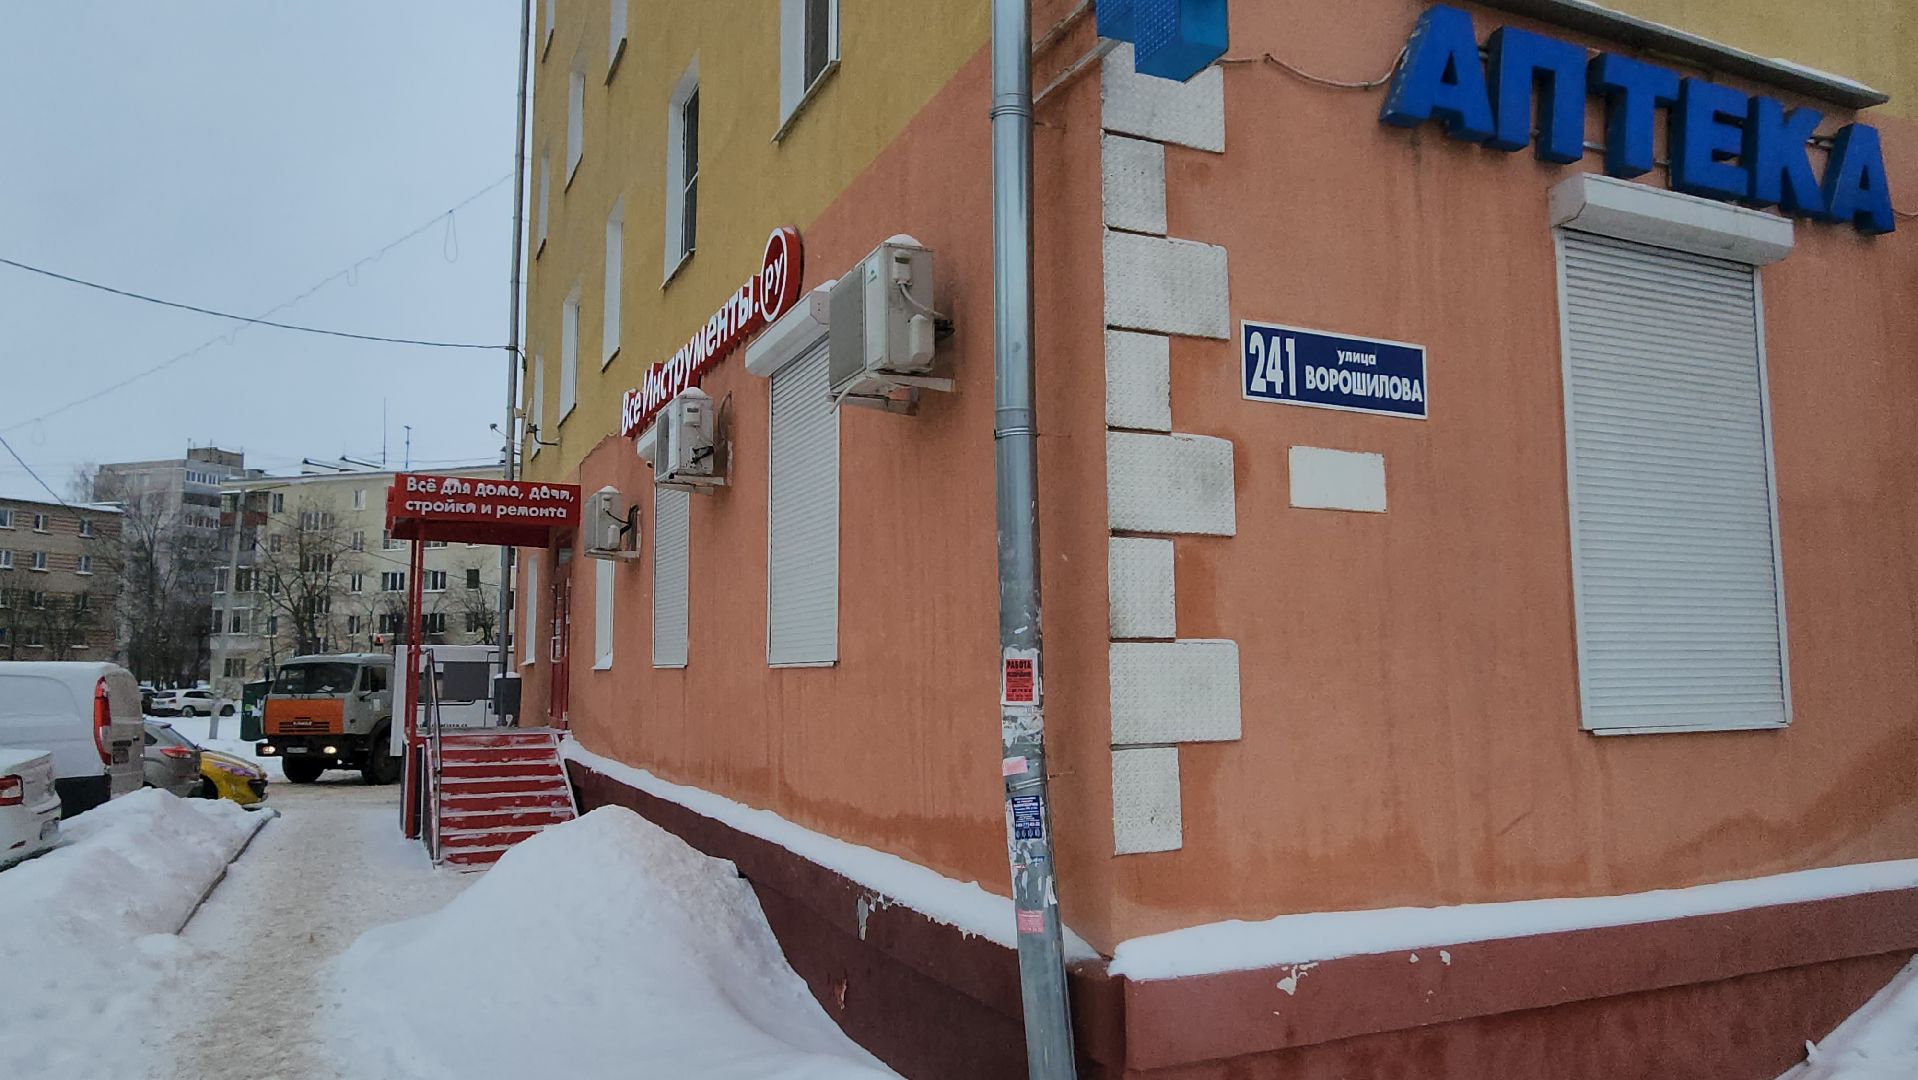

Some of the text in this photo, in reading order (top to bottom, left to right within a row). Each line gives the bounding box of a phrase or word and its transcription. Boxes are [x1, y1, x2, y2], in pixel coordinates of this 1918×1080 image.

[1380, 3, 1896, 234] АПТЕКА
[1249, 331, 1297, 396] 241
[1336, 349, 1377, 367] улица
[1305, 365, 1423, 403] ВОРОШИЛОВА
[406, 476, 574, 503] Всё для дома, дачи,
[405, 499, 567, 519] стройки и ремонта
